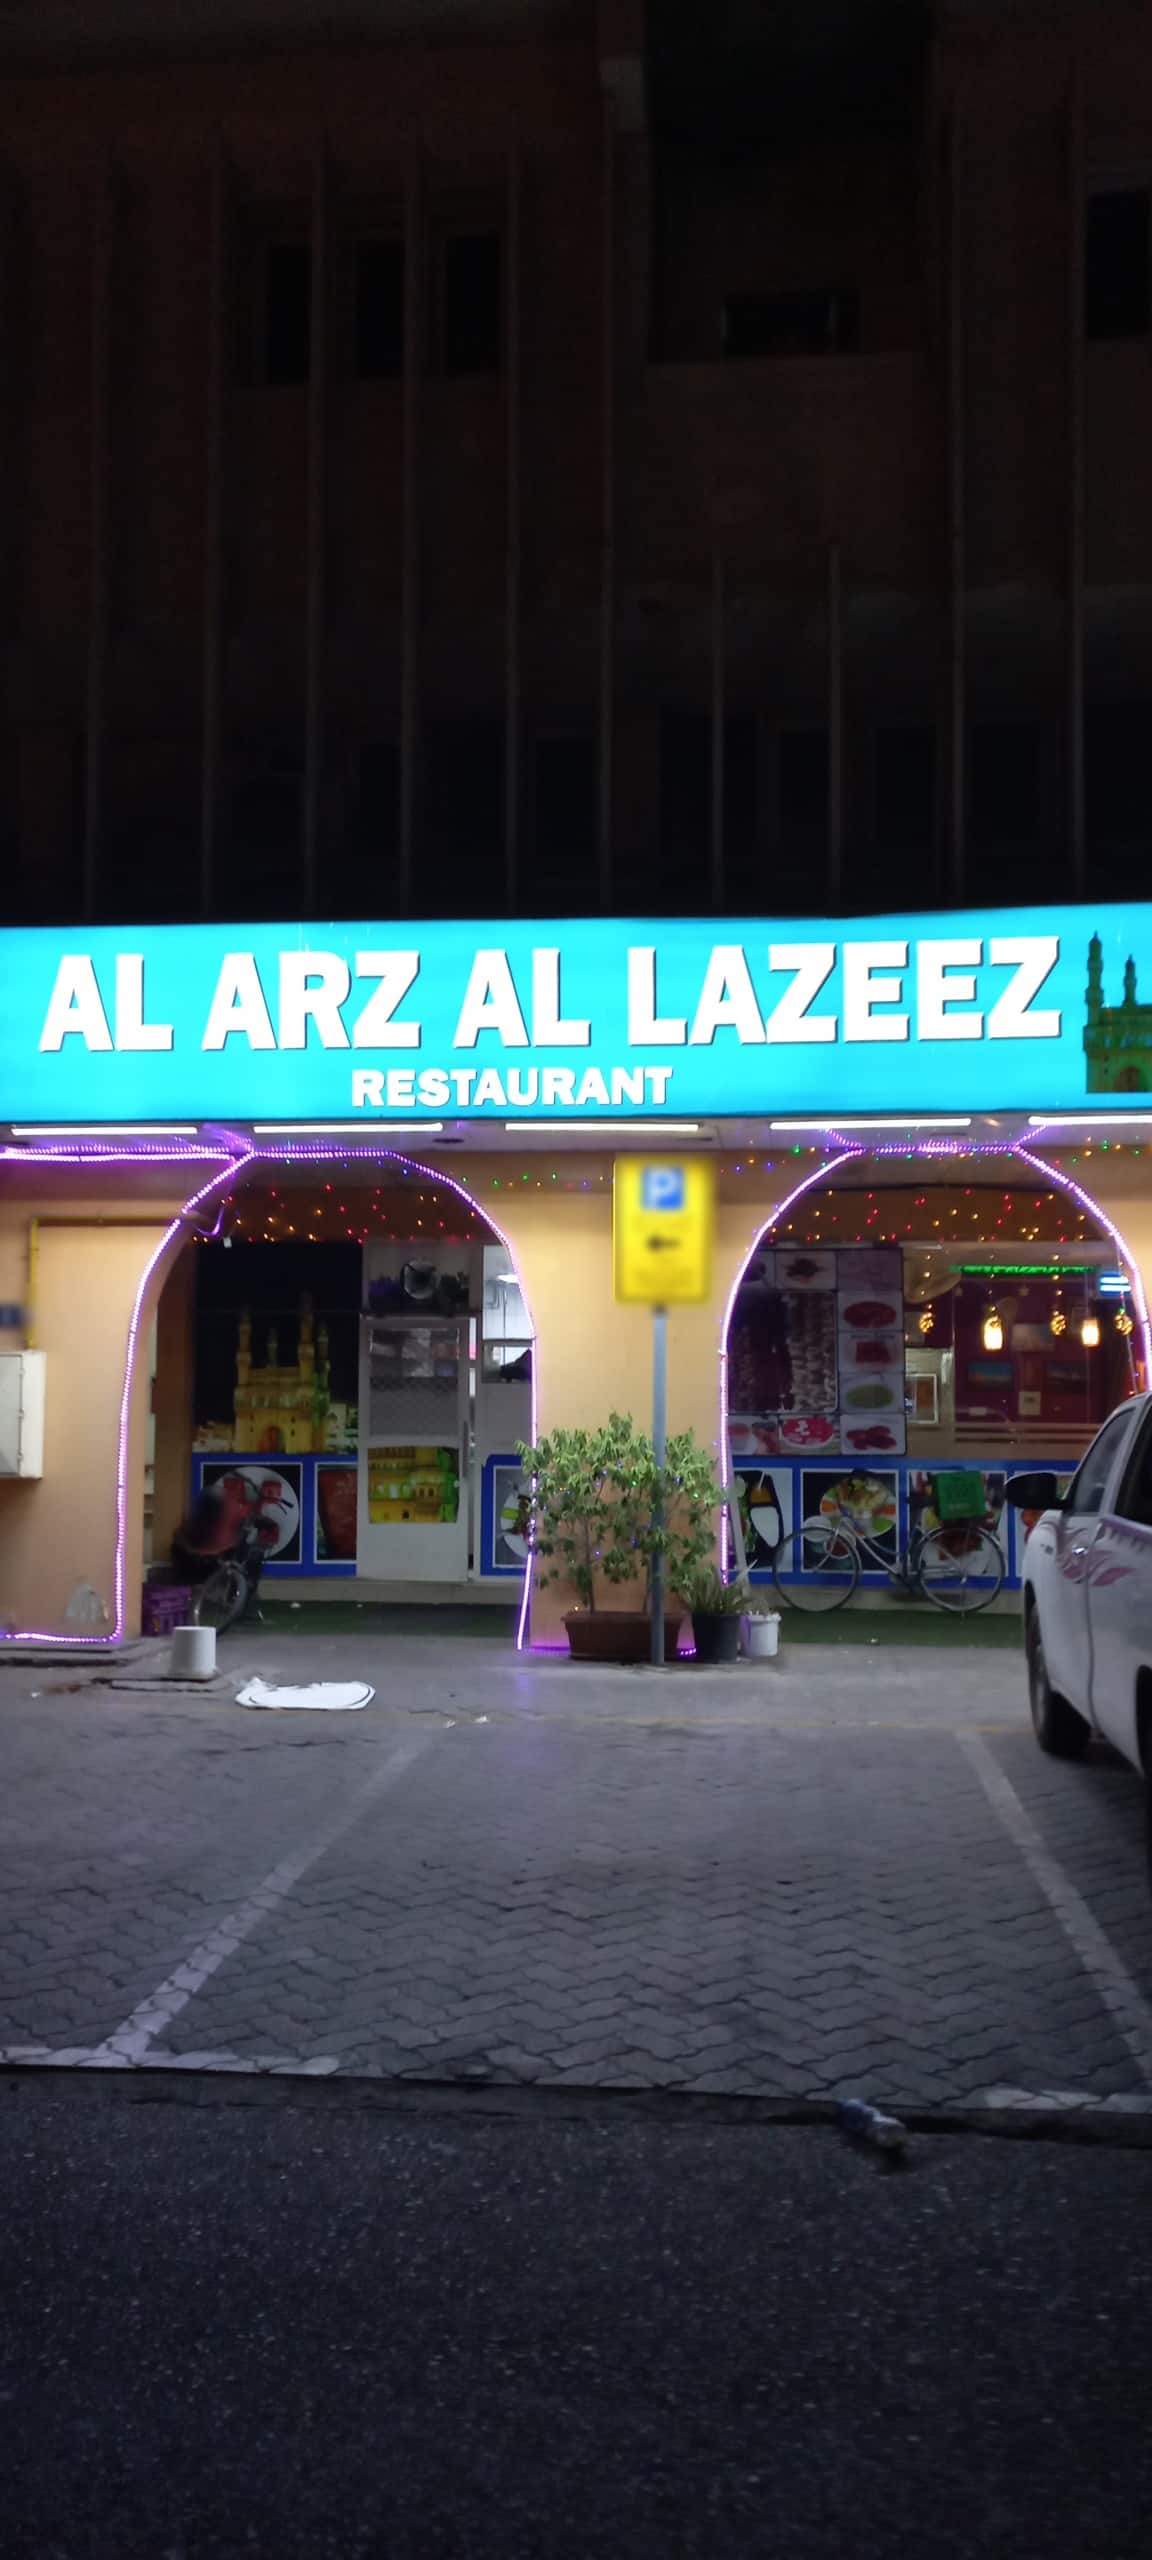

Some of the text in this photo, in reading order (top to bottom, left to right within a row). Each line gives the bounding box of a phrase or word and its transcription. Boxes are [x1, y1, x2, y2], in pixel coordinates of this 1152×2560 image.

[38, 936, 1062, 1053] AL ARZ AL LAZEEZ
[351, 1066, 674, 1107] RESTAURANT
[645, 1168, 678, 1210] P
